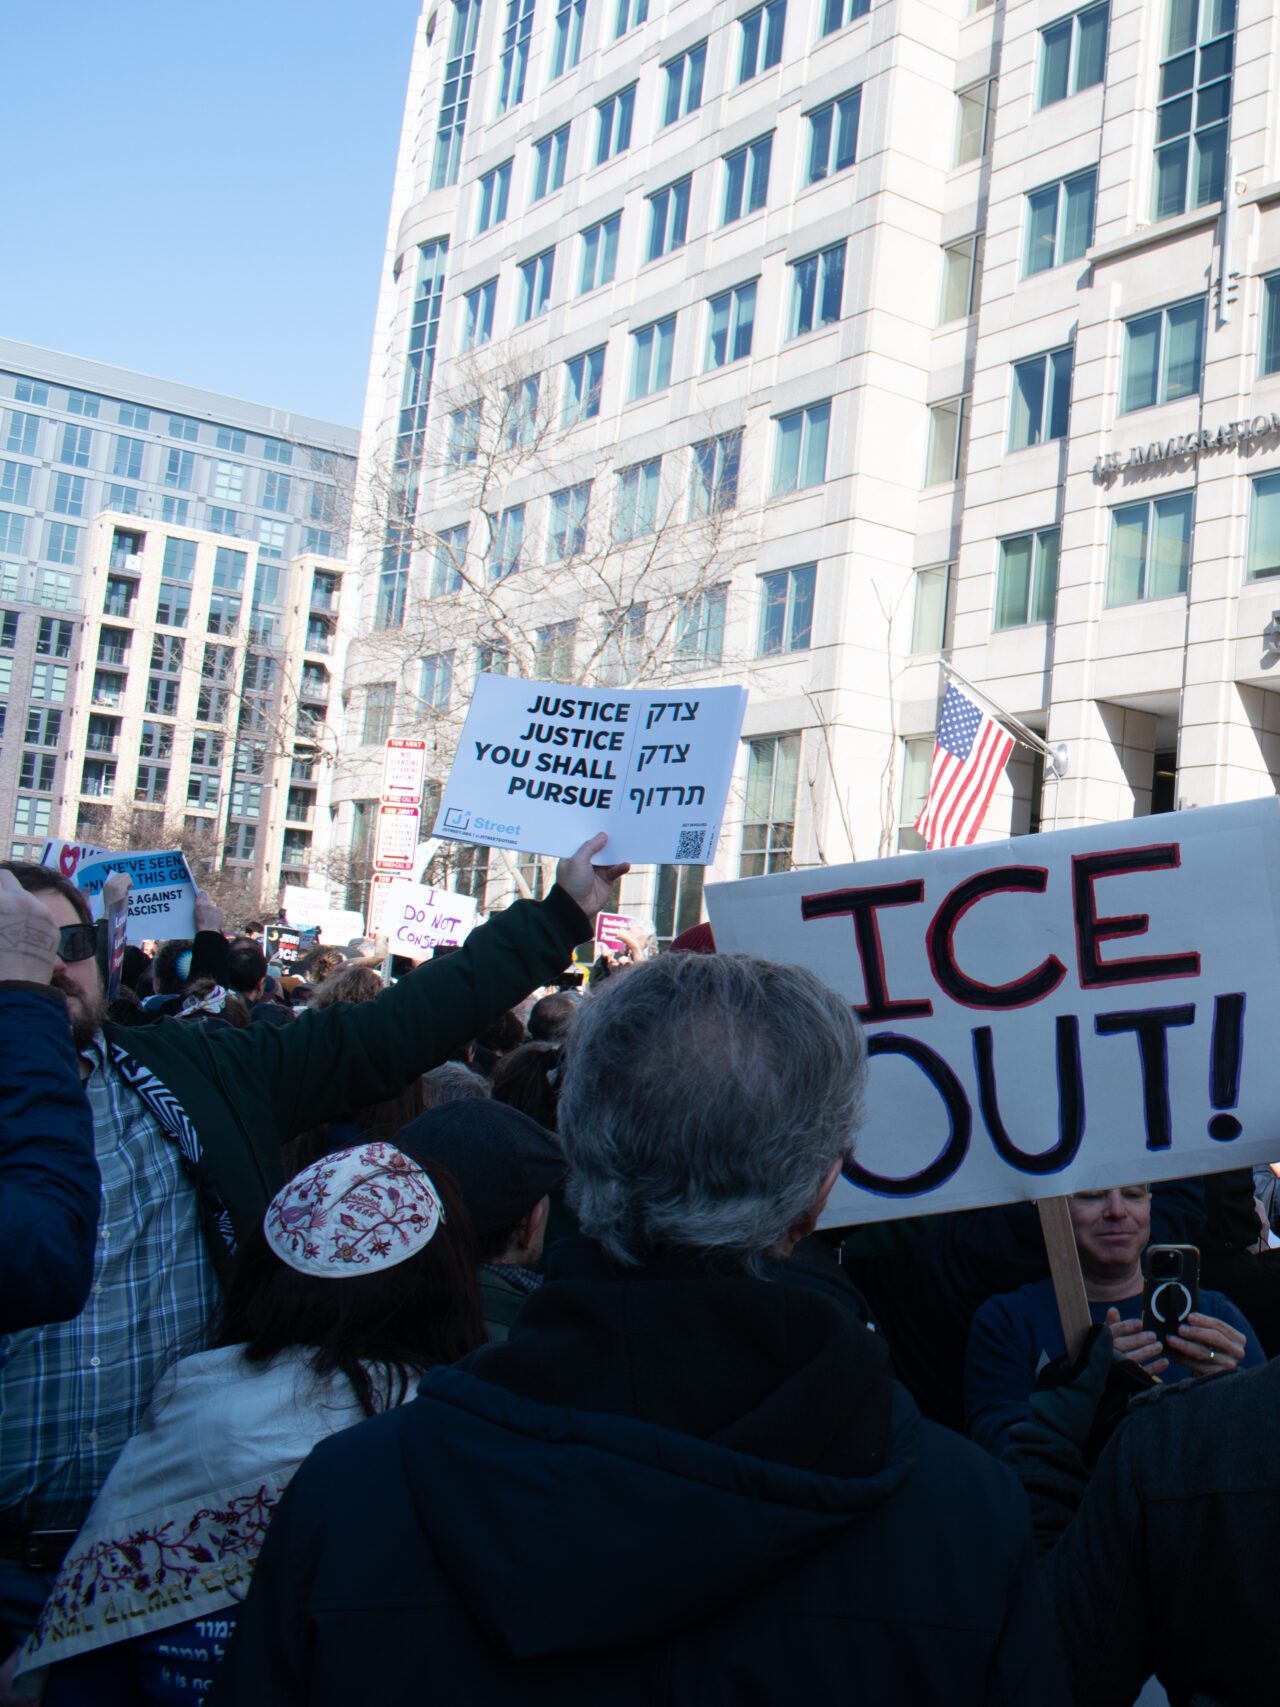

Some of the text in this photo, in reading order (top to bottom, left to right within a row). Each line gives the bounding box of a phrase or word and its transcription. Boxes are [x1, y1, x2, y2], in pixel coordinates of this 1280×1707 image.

[527, 695, 631, 722] JUSTICE
[646, 701, 700, 730] צדק
[520, 722, 625, 751] JUSTICE
[474, 741, 617, 780] YOU SHALL
[637, 743, 691, 772] צדק
[507, 776, 614, 809] PURSUE
[629, 785, 706, 814] תרדוף
[473, 816, 521, 836] Street
[102, 854, 181, 874] WE'VE SEEN
[136, 870, 166, 884] THIS
[169, 868, 190, 881] GO
[128, 902, 170, 917] ASCISTS
[137, 889, 182, 904] AGAINST
[426, 889, 438, 907] I
[404, 905, 462, 932] DO NOT
[801, 842, 1201, 1024] ICE
[279, 947, 298, 961] ICE
[841, 992, 1247, 1198] OUT!
[175, 1671, 187, 1690] is
